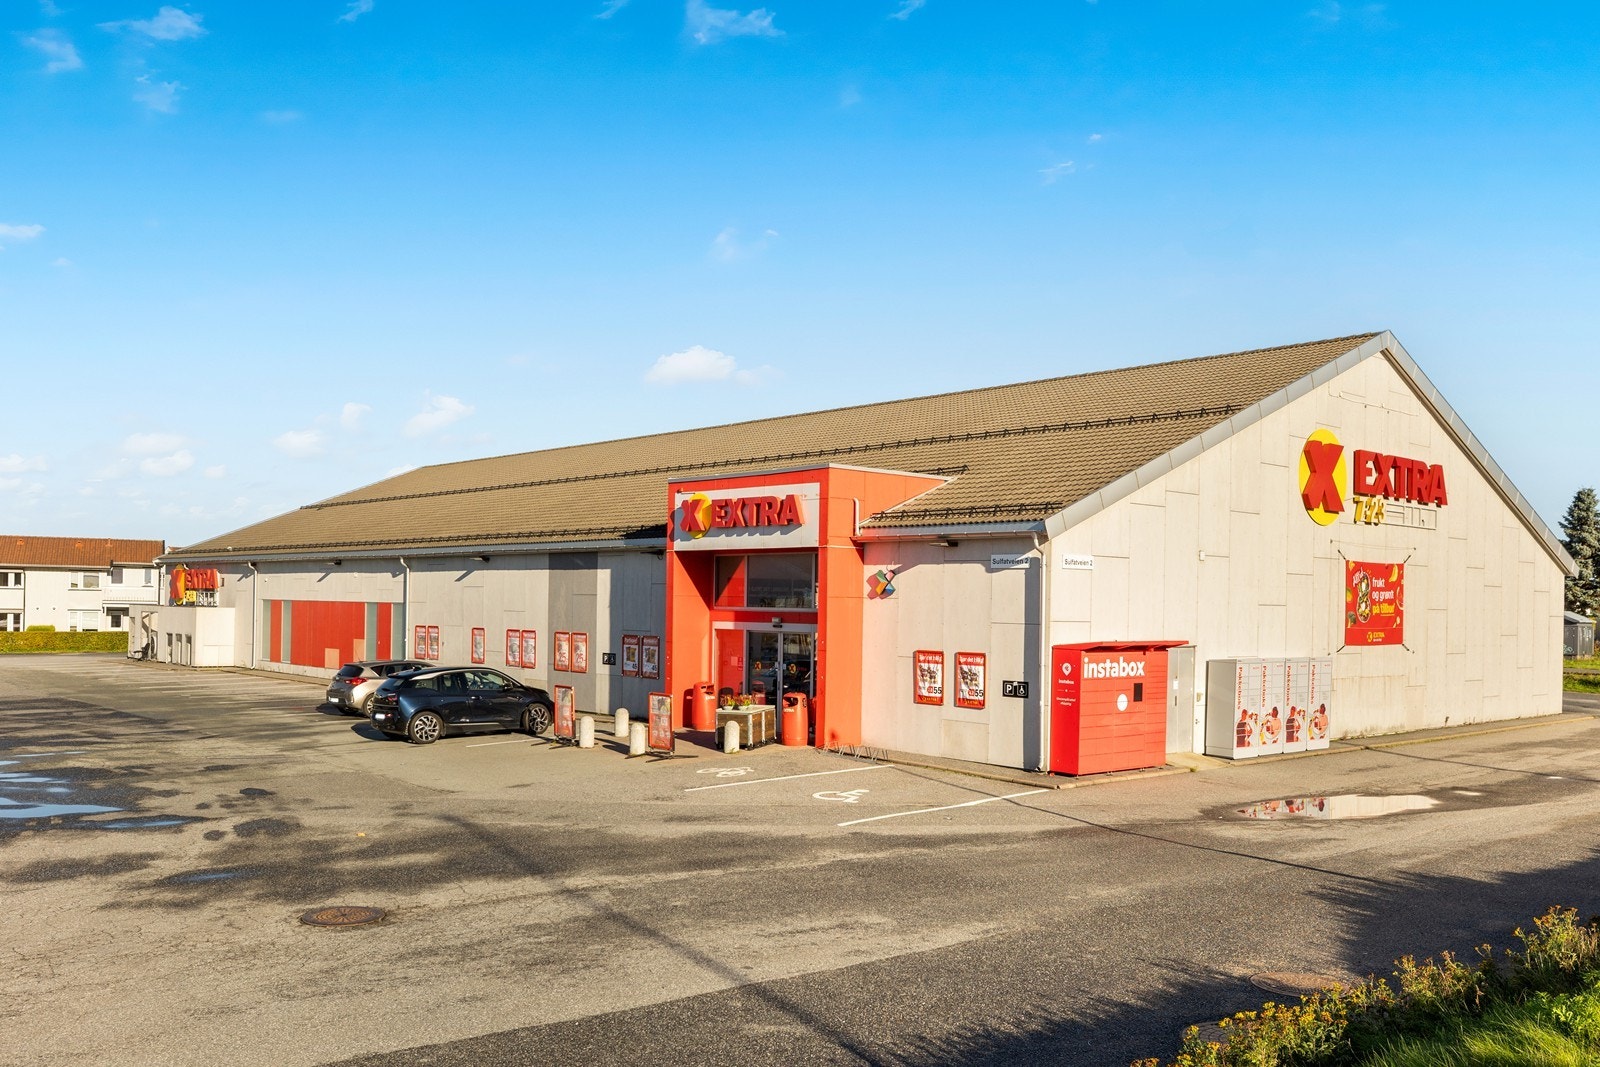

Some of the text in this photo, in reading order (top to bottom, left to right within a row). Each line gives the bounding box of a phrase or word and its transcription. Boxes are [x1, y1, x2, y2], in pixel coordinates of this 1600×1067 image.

[1353, 449, 1448, 506] EXTRA
[711, 494, 805, 528] EXTRA
[992, 557, 1024, 565] Sulfatveien
[1064, 558, 1090, 566] Sulfatveien
[185, 568, 219, 589] EXTRA
[1372, 577, 1385, 588] frukt
[1371, 590, 1394, 602] og grønt
[1372, 603, 1380, 616] på
[1083, 656, 1145, 679] instabox
[934, 686, 942, 694] 55
[975, 689, 984, 697] 55
